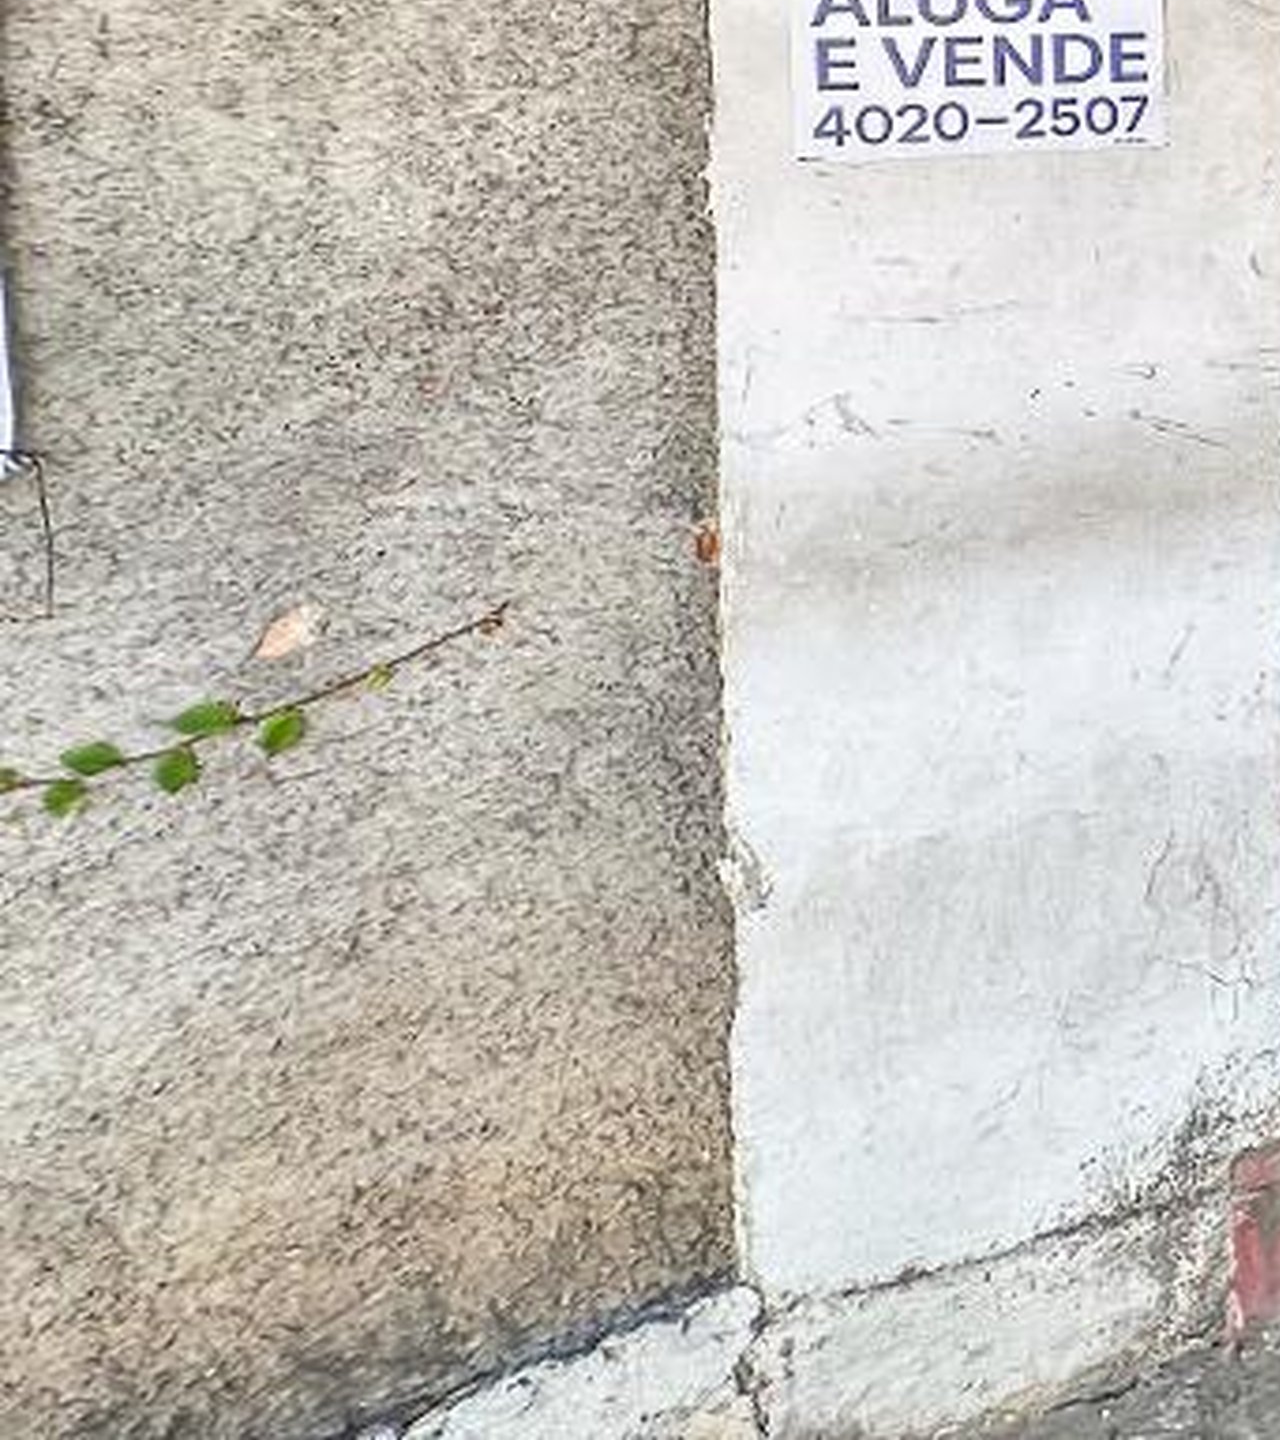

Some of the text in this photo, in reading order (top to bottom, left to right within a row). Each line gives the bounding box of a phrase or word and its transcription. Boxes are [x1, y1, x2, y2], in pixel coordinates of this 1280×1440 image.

[815, 32, 1149, 92] E VENDE
[813, 95, 1149, 147] 4020-2507
